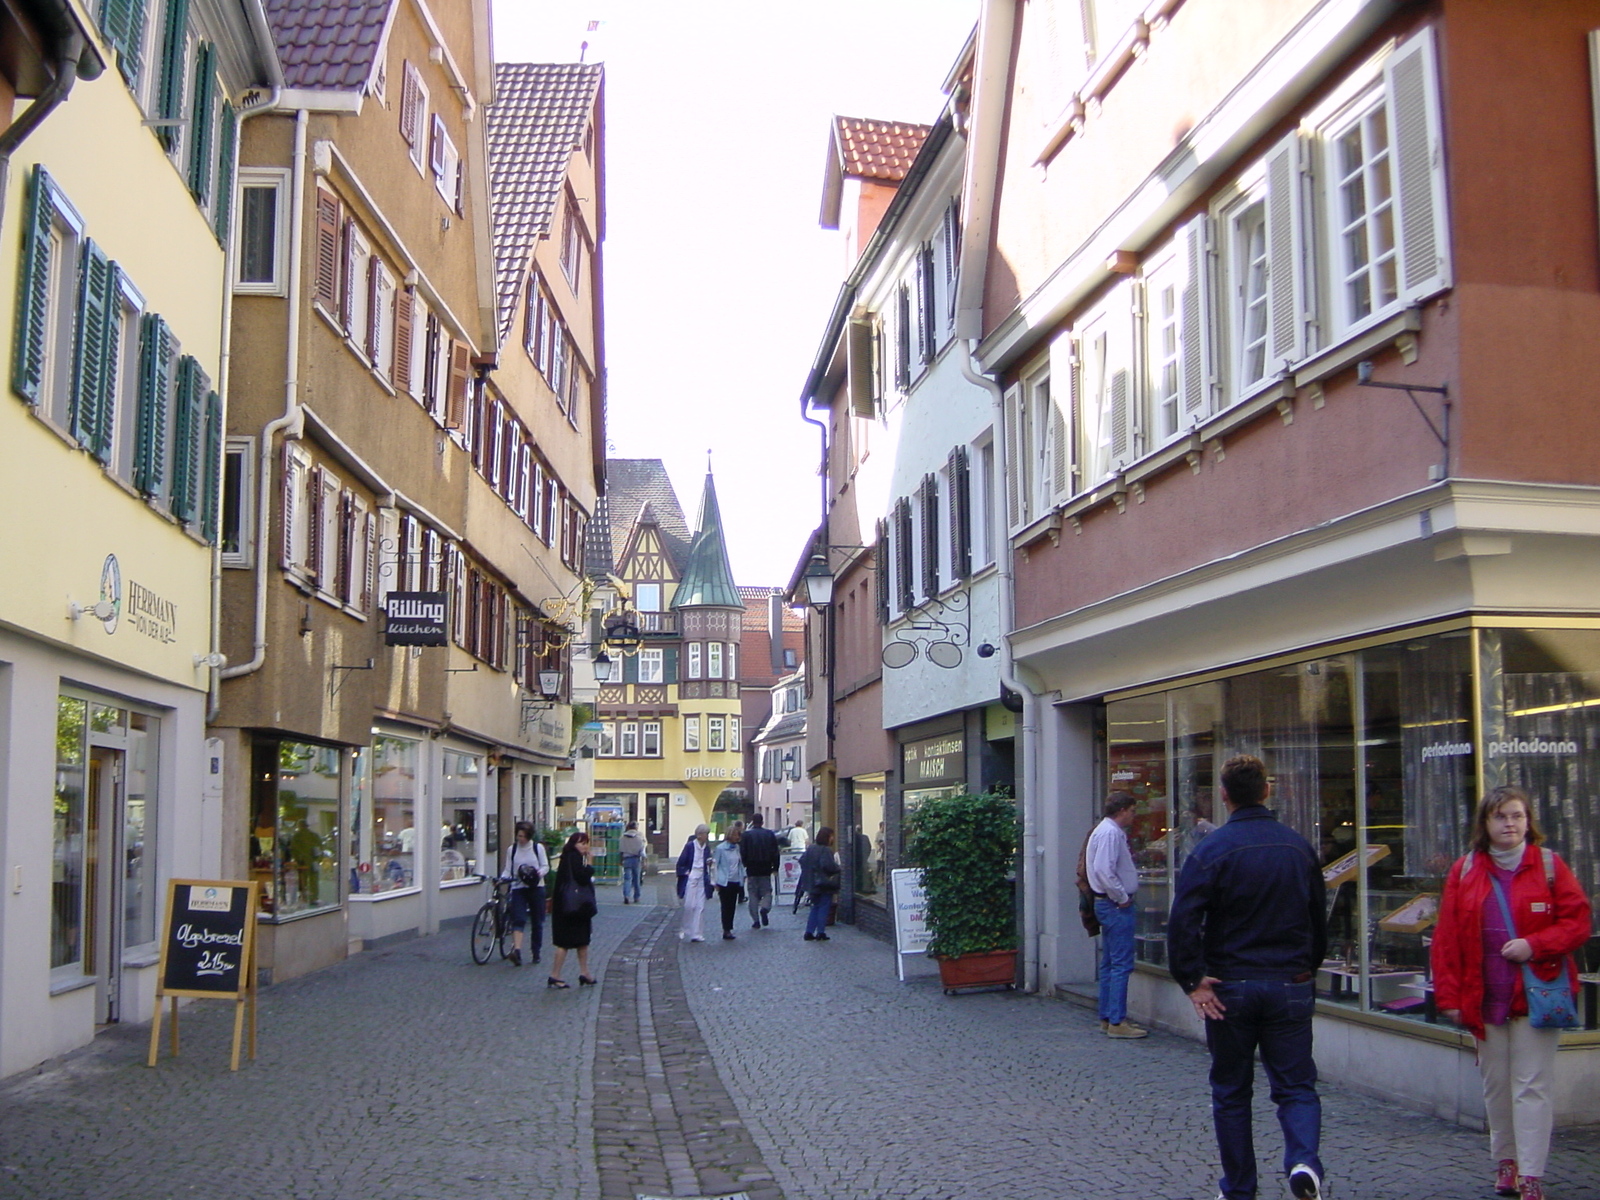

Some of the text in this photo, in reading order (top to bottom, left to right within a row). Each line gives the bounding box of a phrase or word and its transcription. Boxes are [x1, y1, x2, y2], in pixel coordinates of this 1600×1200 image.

[127, 579, 176, 635] HERRMANN
[388, 599, 444, 623] Rilling
[148, 619, 159, 640] DER
[387, 623, 444, 634] Küchen
[1422, 741, 1472, 762] perladonna
[1489, 737, 1577, 758] perladonna
[684, 765, 727, 780] galerie
